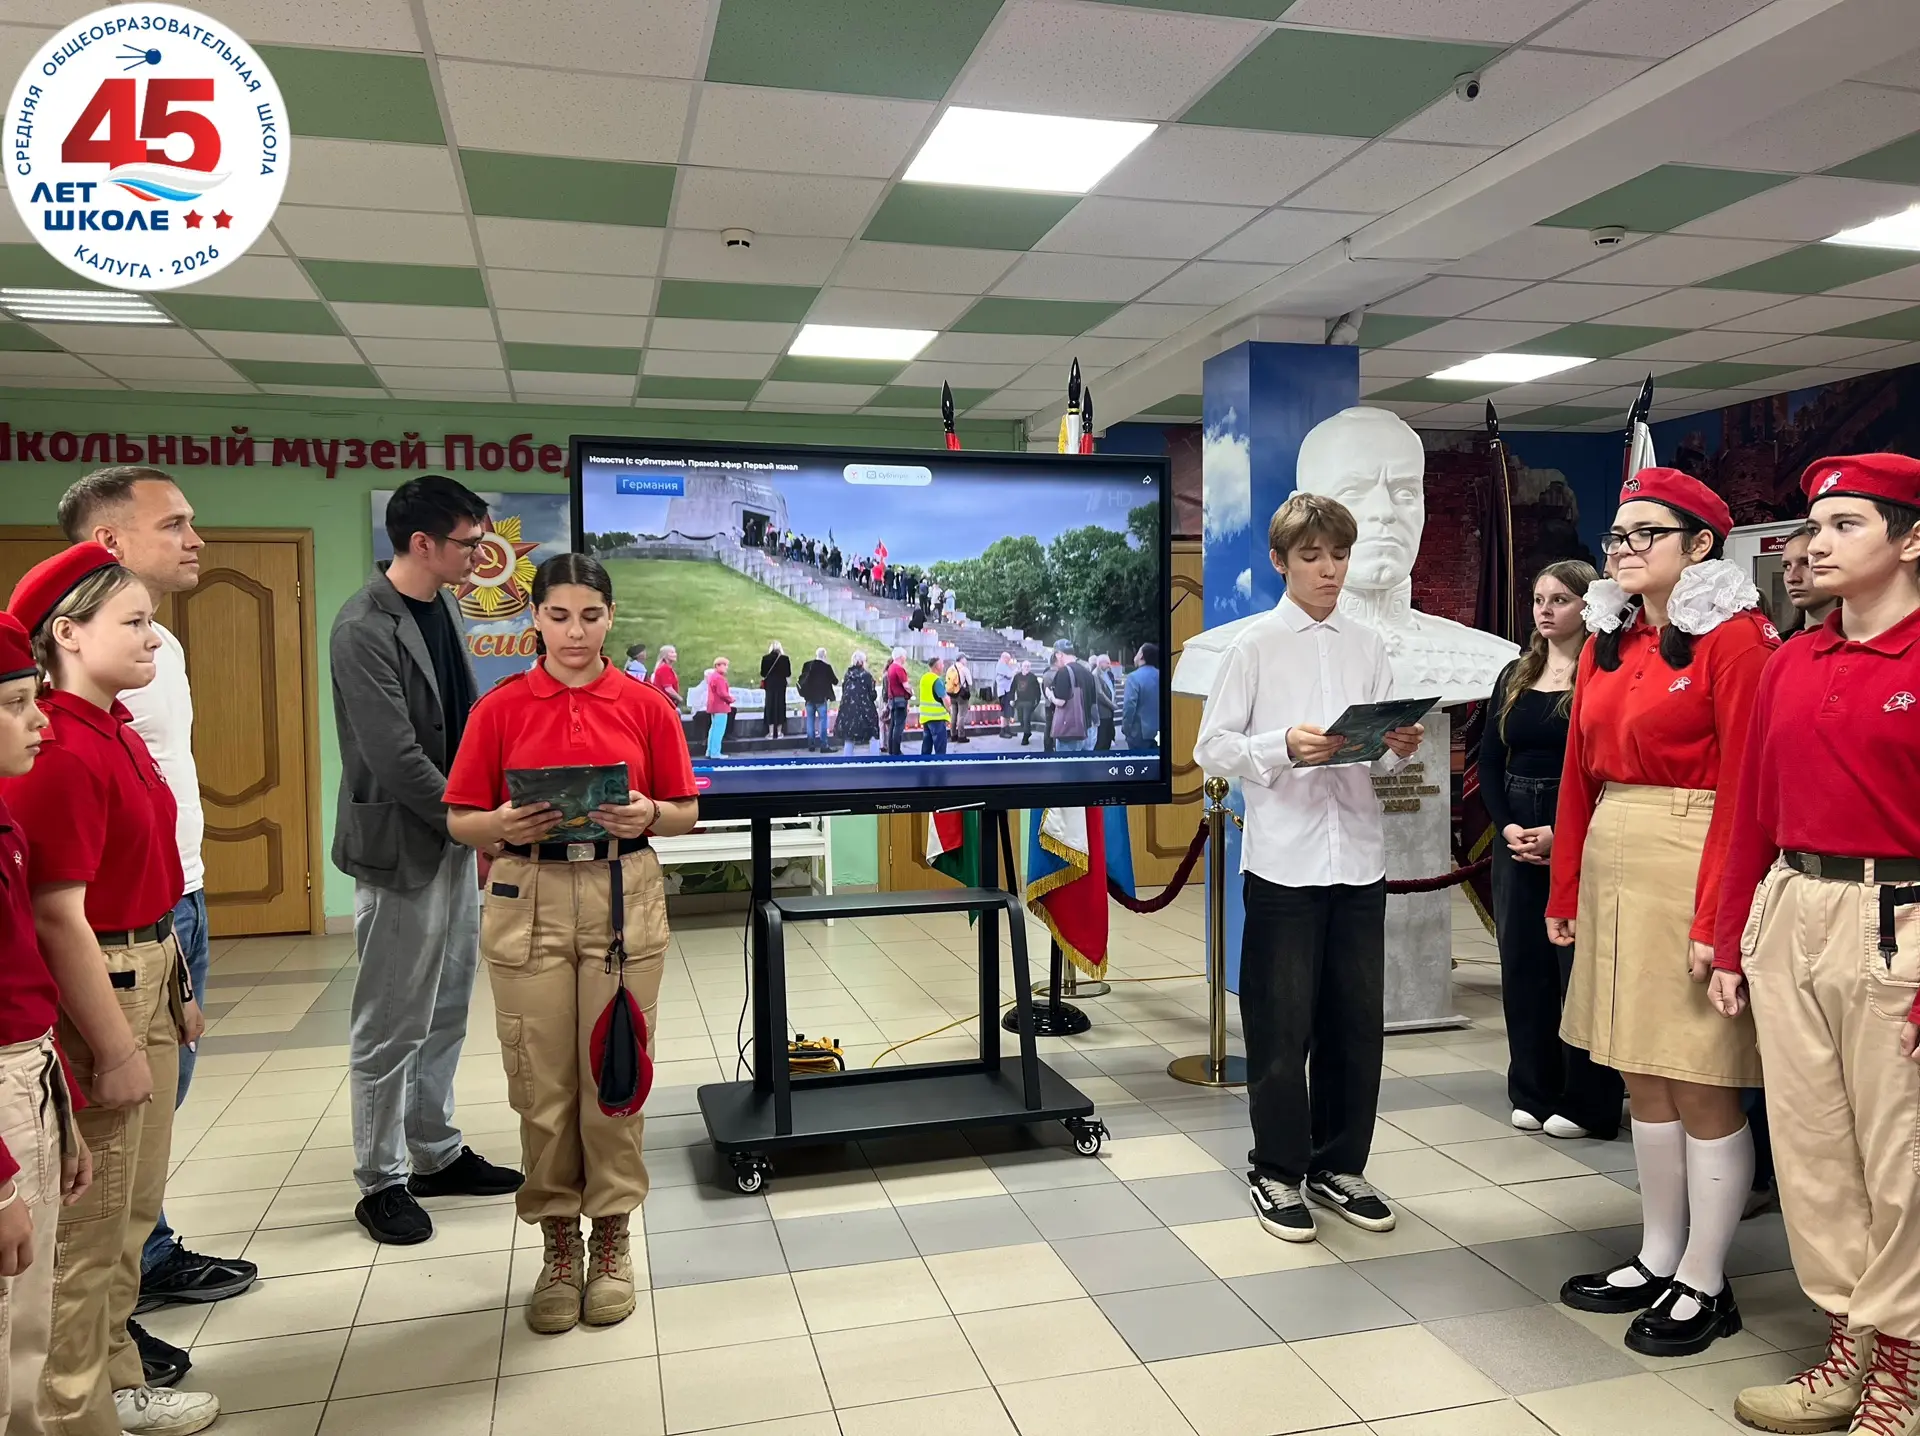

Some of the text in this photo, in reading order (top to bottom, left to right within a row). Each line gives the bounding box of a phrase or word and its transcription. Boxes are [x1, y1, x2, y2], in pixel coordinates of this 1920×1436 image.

[272, 431, 427, 478] музей
[444, 433, 570, 478] Побе
[589, 455, 625, 465] Новости
[688, 459, 720, 469] Прямой
[721, 461, 742, 469] эфир
[743, 461, 774, 470] Первый
[776, 463, 798, 471] канал
[622, 478, 678, 491] Германия
[1108, 490, 1133, 507] HD
